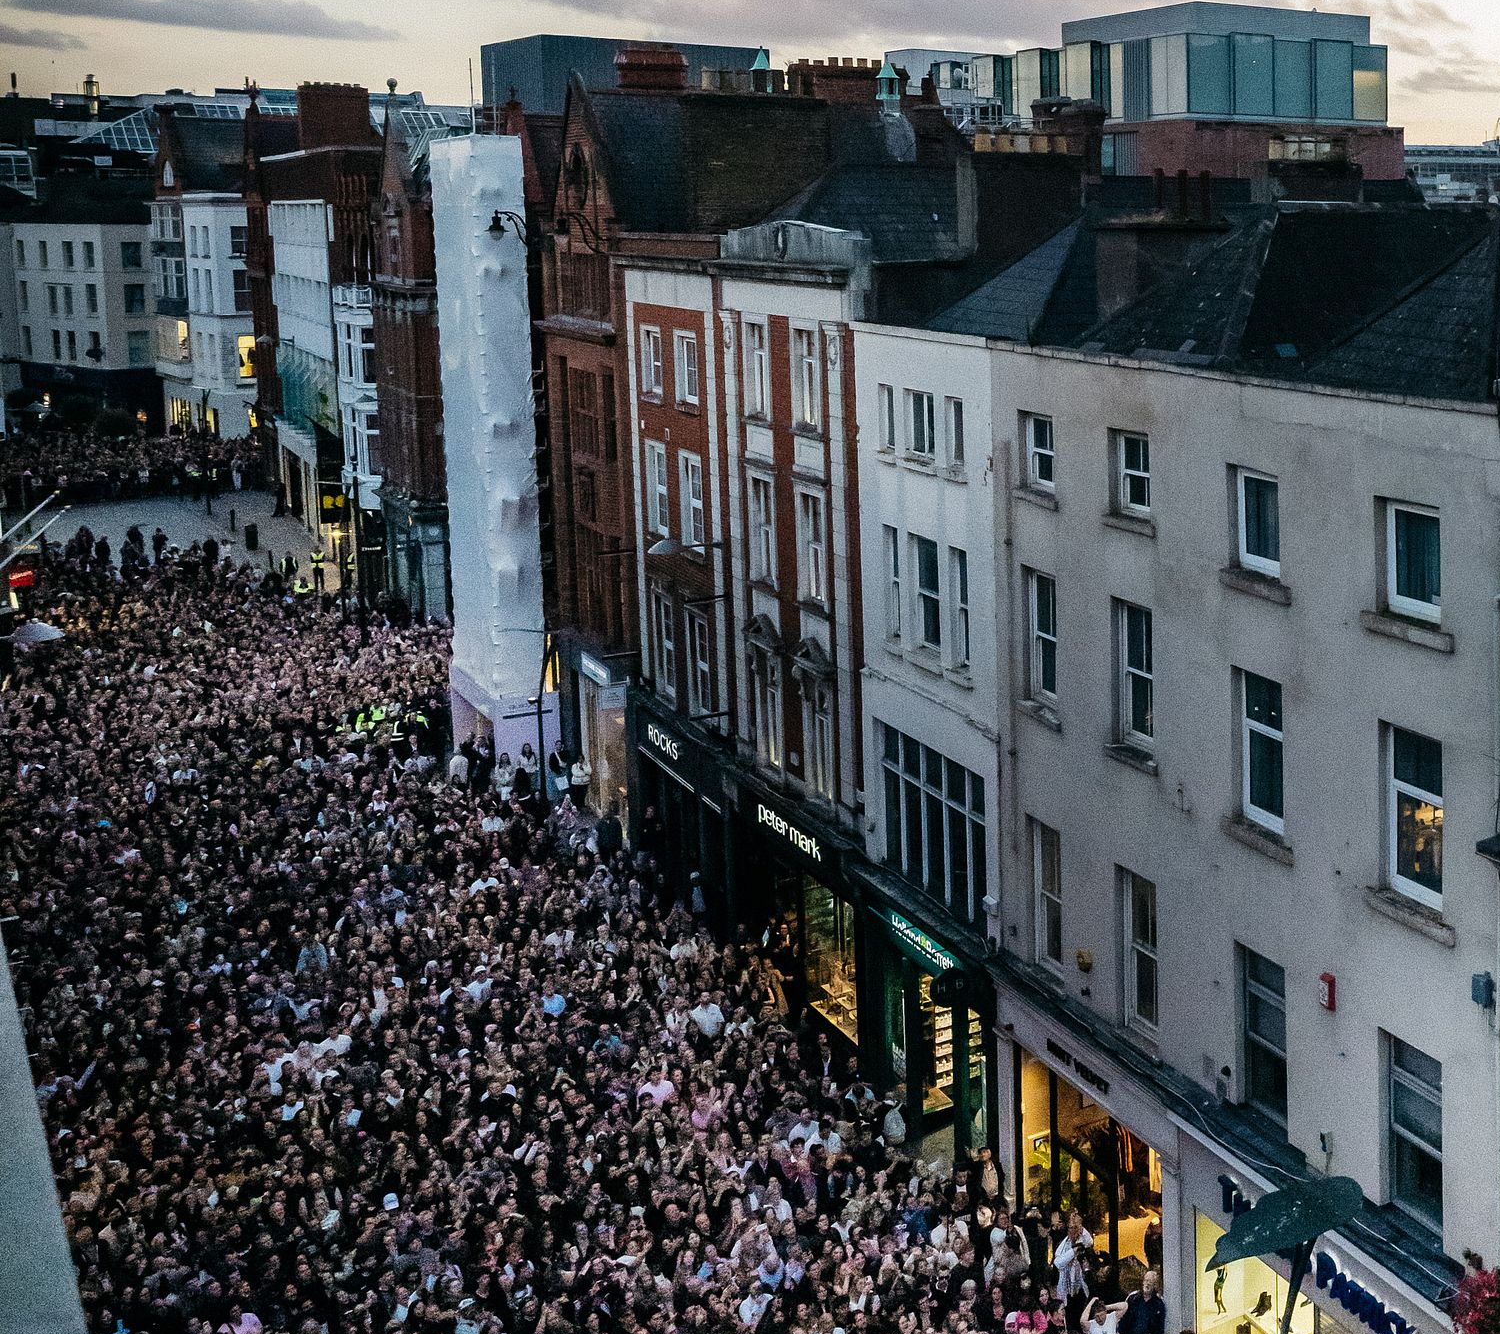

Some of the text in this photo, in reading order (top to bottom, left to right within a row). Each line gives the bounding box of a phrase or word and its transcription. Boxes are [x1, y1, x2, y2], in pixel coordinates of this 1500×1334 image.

[647, 723, 679, 761] ROCKS
[757, 803, 822, 862] peter mark
